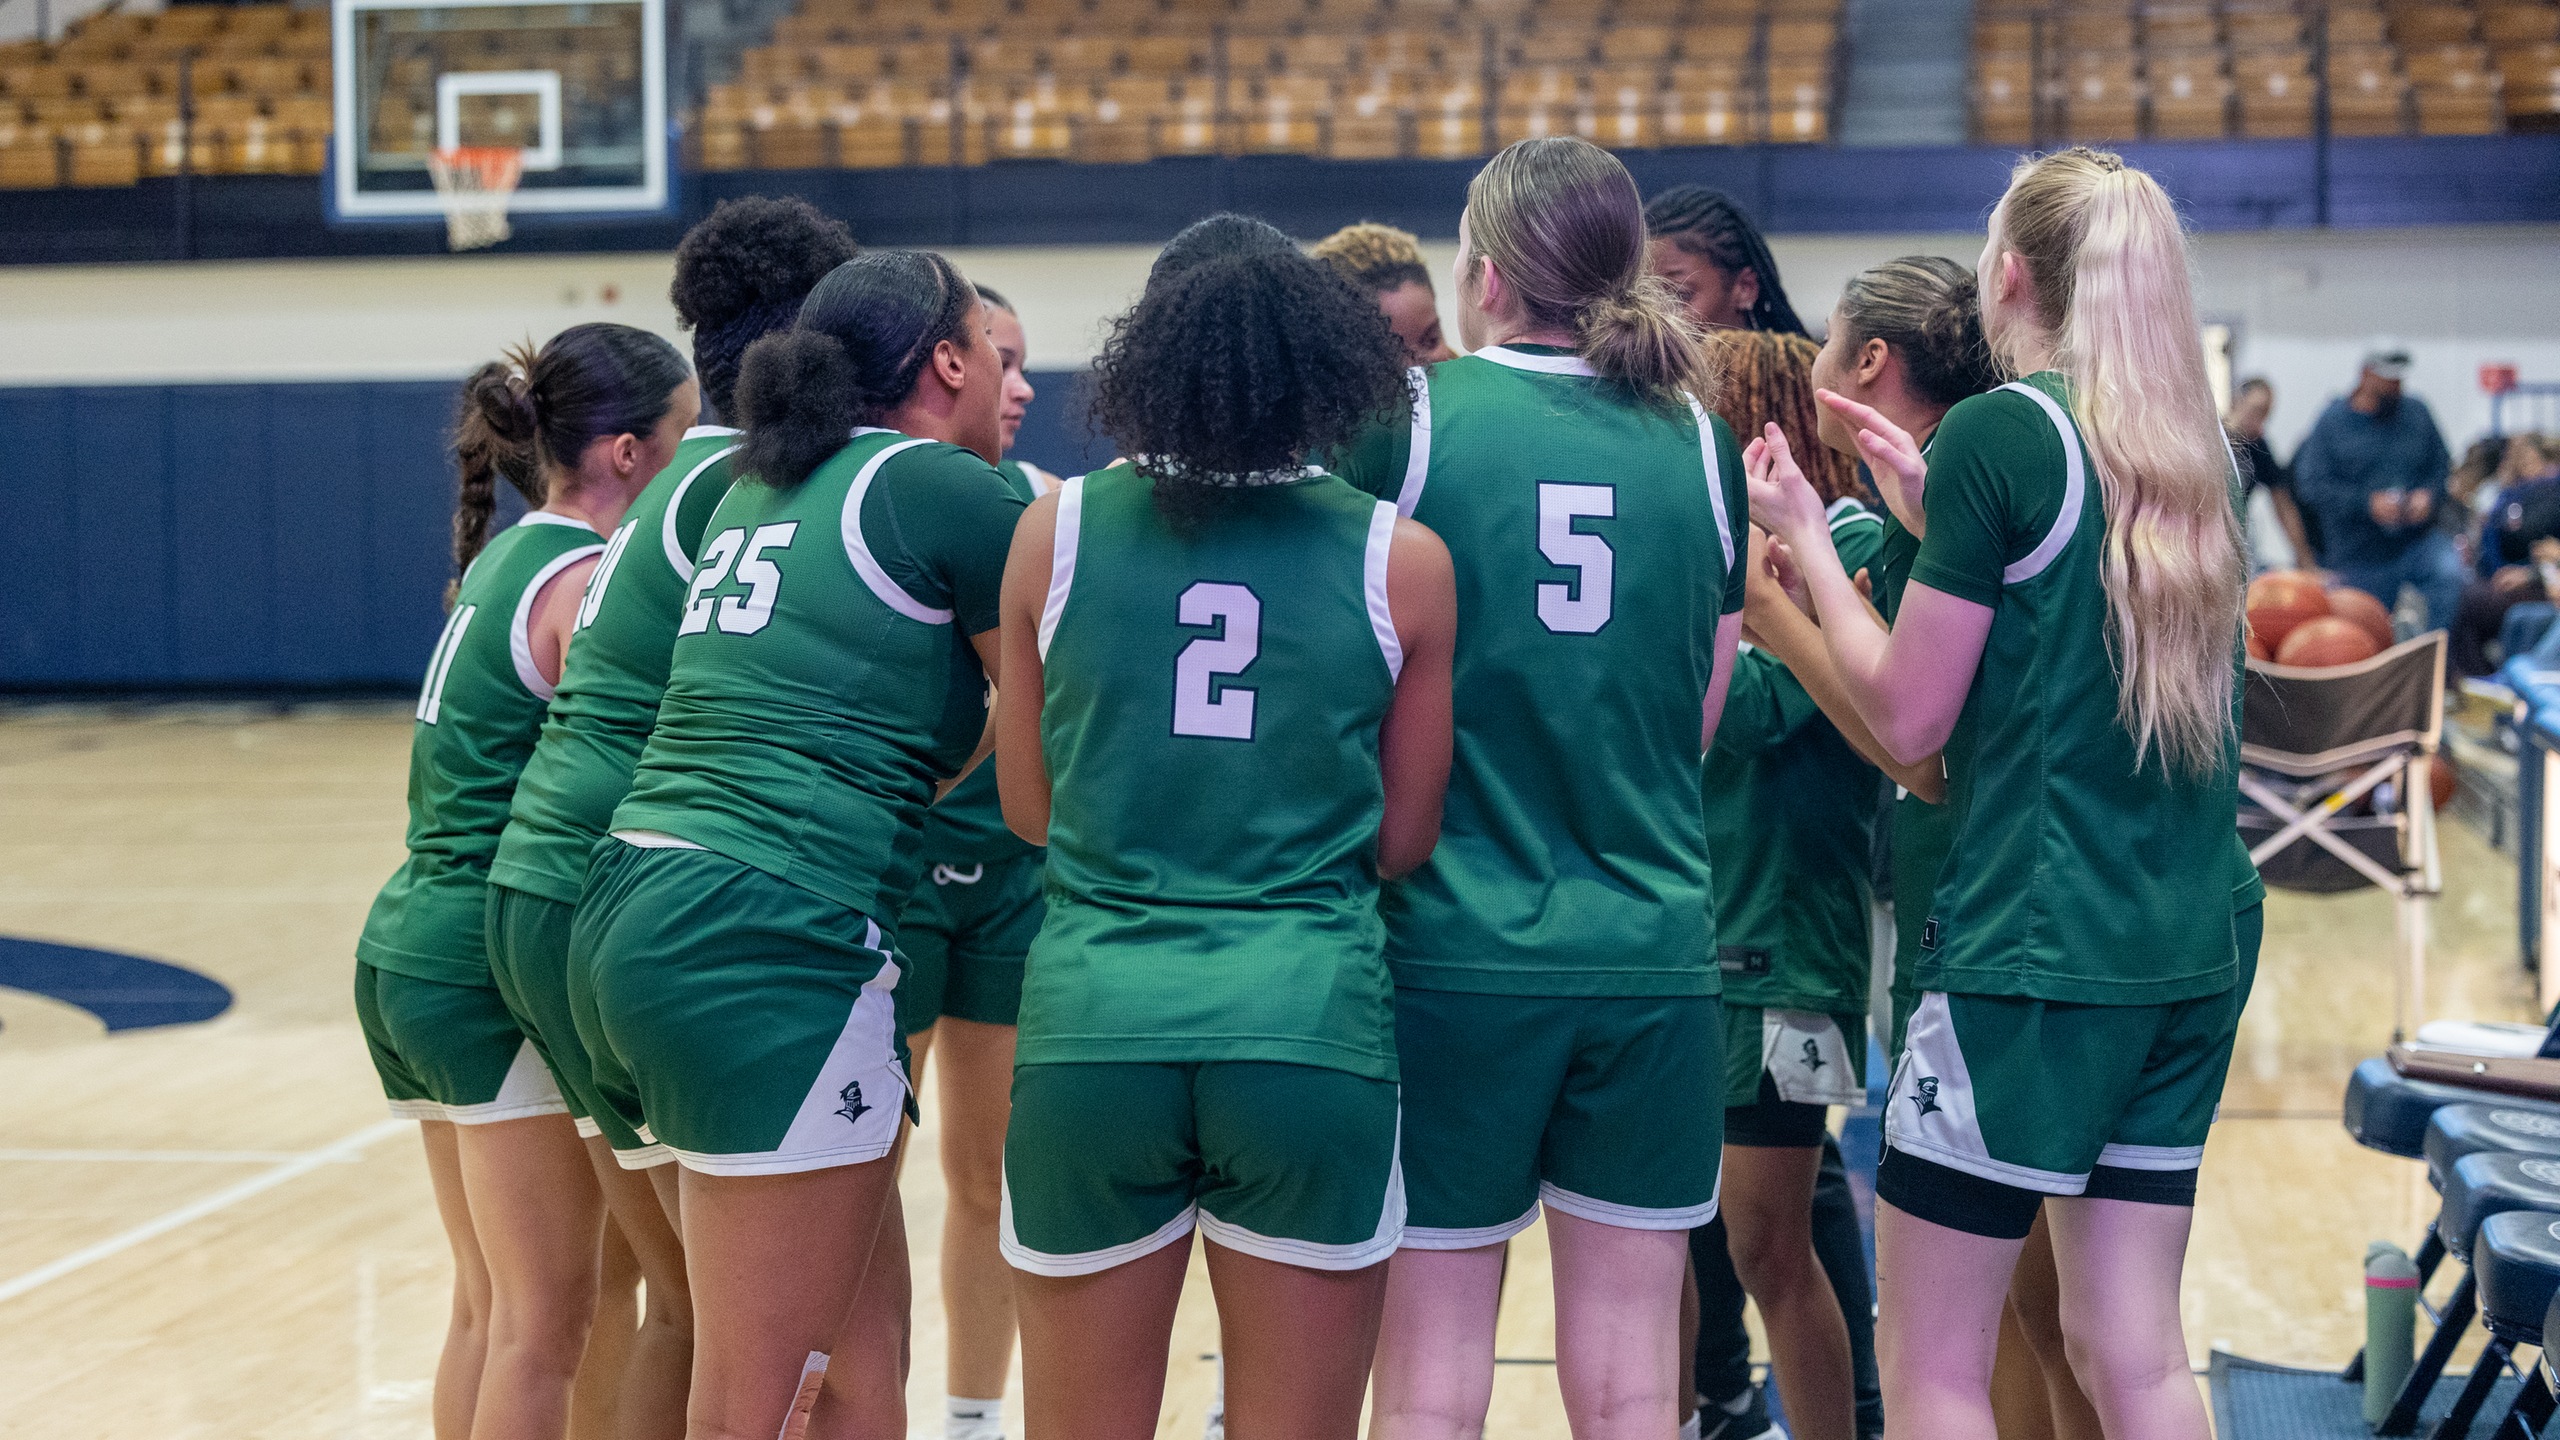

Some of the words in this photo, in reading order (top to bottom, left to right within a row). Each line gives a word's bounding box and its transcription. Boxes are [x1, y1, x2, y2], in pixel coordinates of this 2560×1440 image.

[677, 519, 801, 639] 25
[1535, 480, 1617, 636] 5
[415, 603, 477, 726] 11
[1170, 579, 1264, 743] 2
